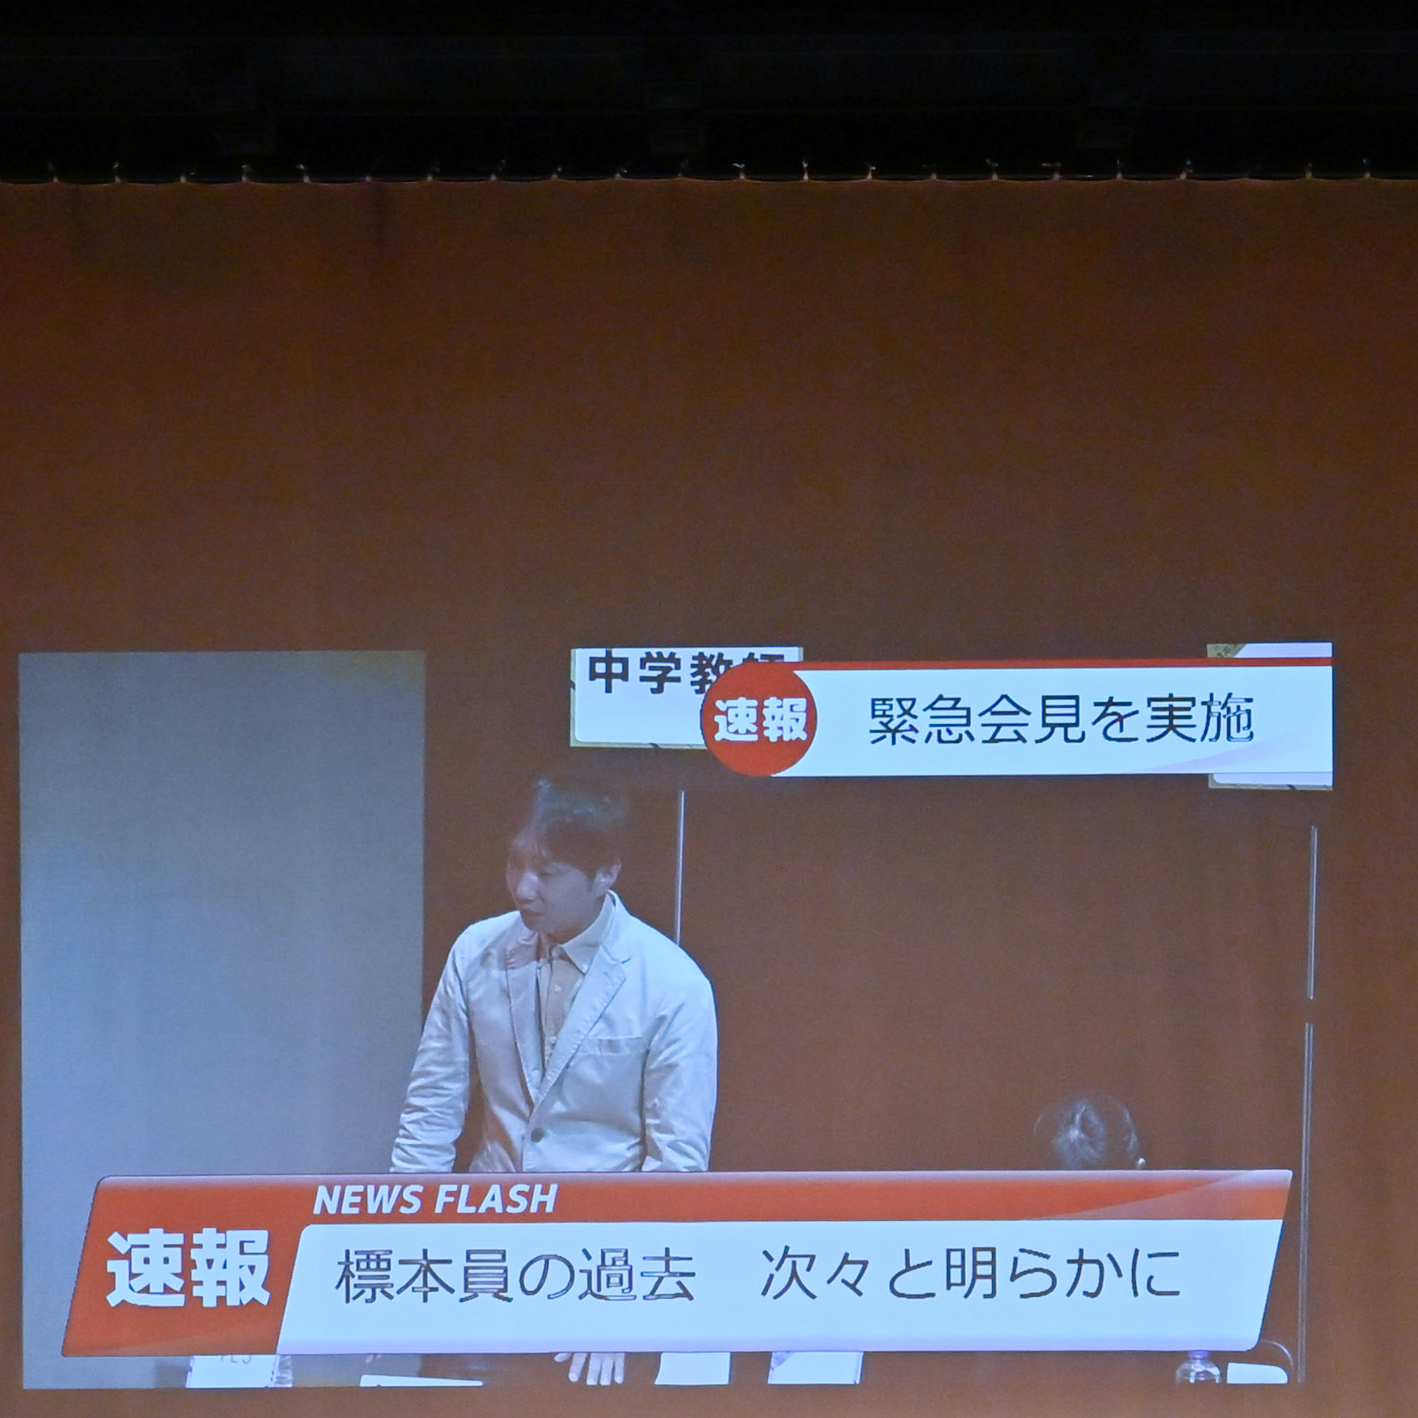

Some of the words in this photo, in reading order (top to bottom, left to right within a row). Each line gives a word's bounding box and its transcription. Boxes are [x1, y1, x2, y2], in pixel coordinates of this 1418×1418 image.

[588, 650, 785, 694] 中学教
[713, 696, 809, 743] 速報
[869, 692, 1255, 745] 緊急会見を実施
[308, 1184, 423, 1215] NEWS
[434, 1184, 559, 1214] FLASH
[106, 1227, 272, 1308] 速報
[334, 1247, 696, 1304] 標本員の過去
[760, 1245, 1181, 1301] 次々と明らかに
